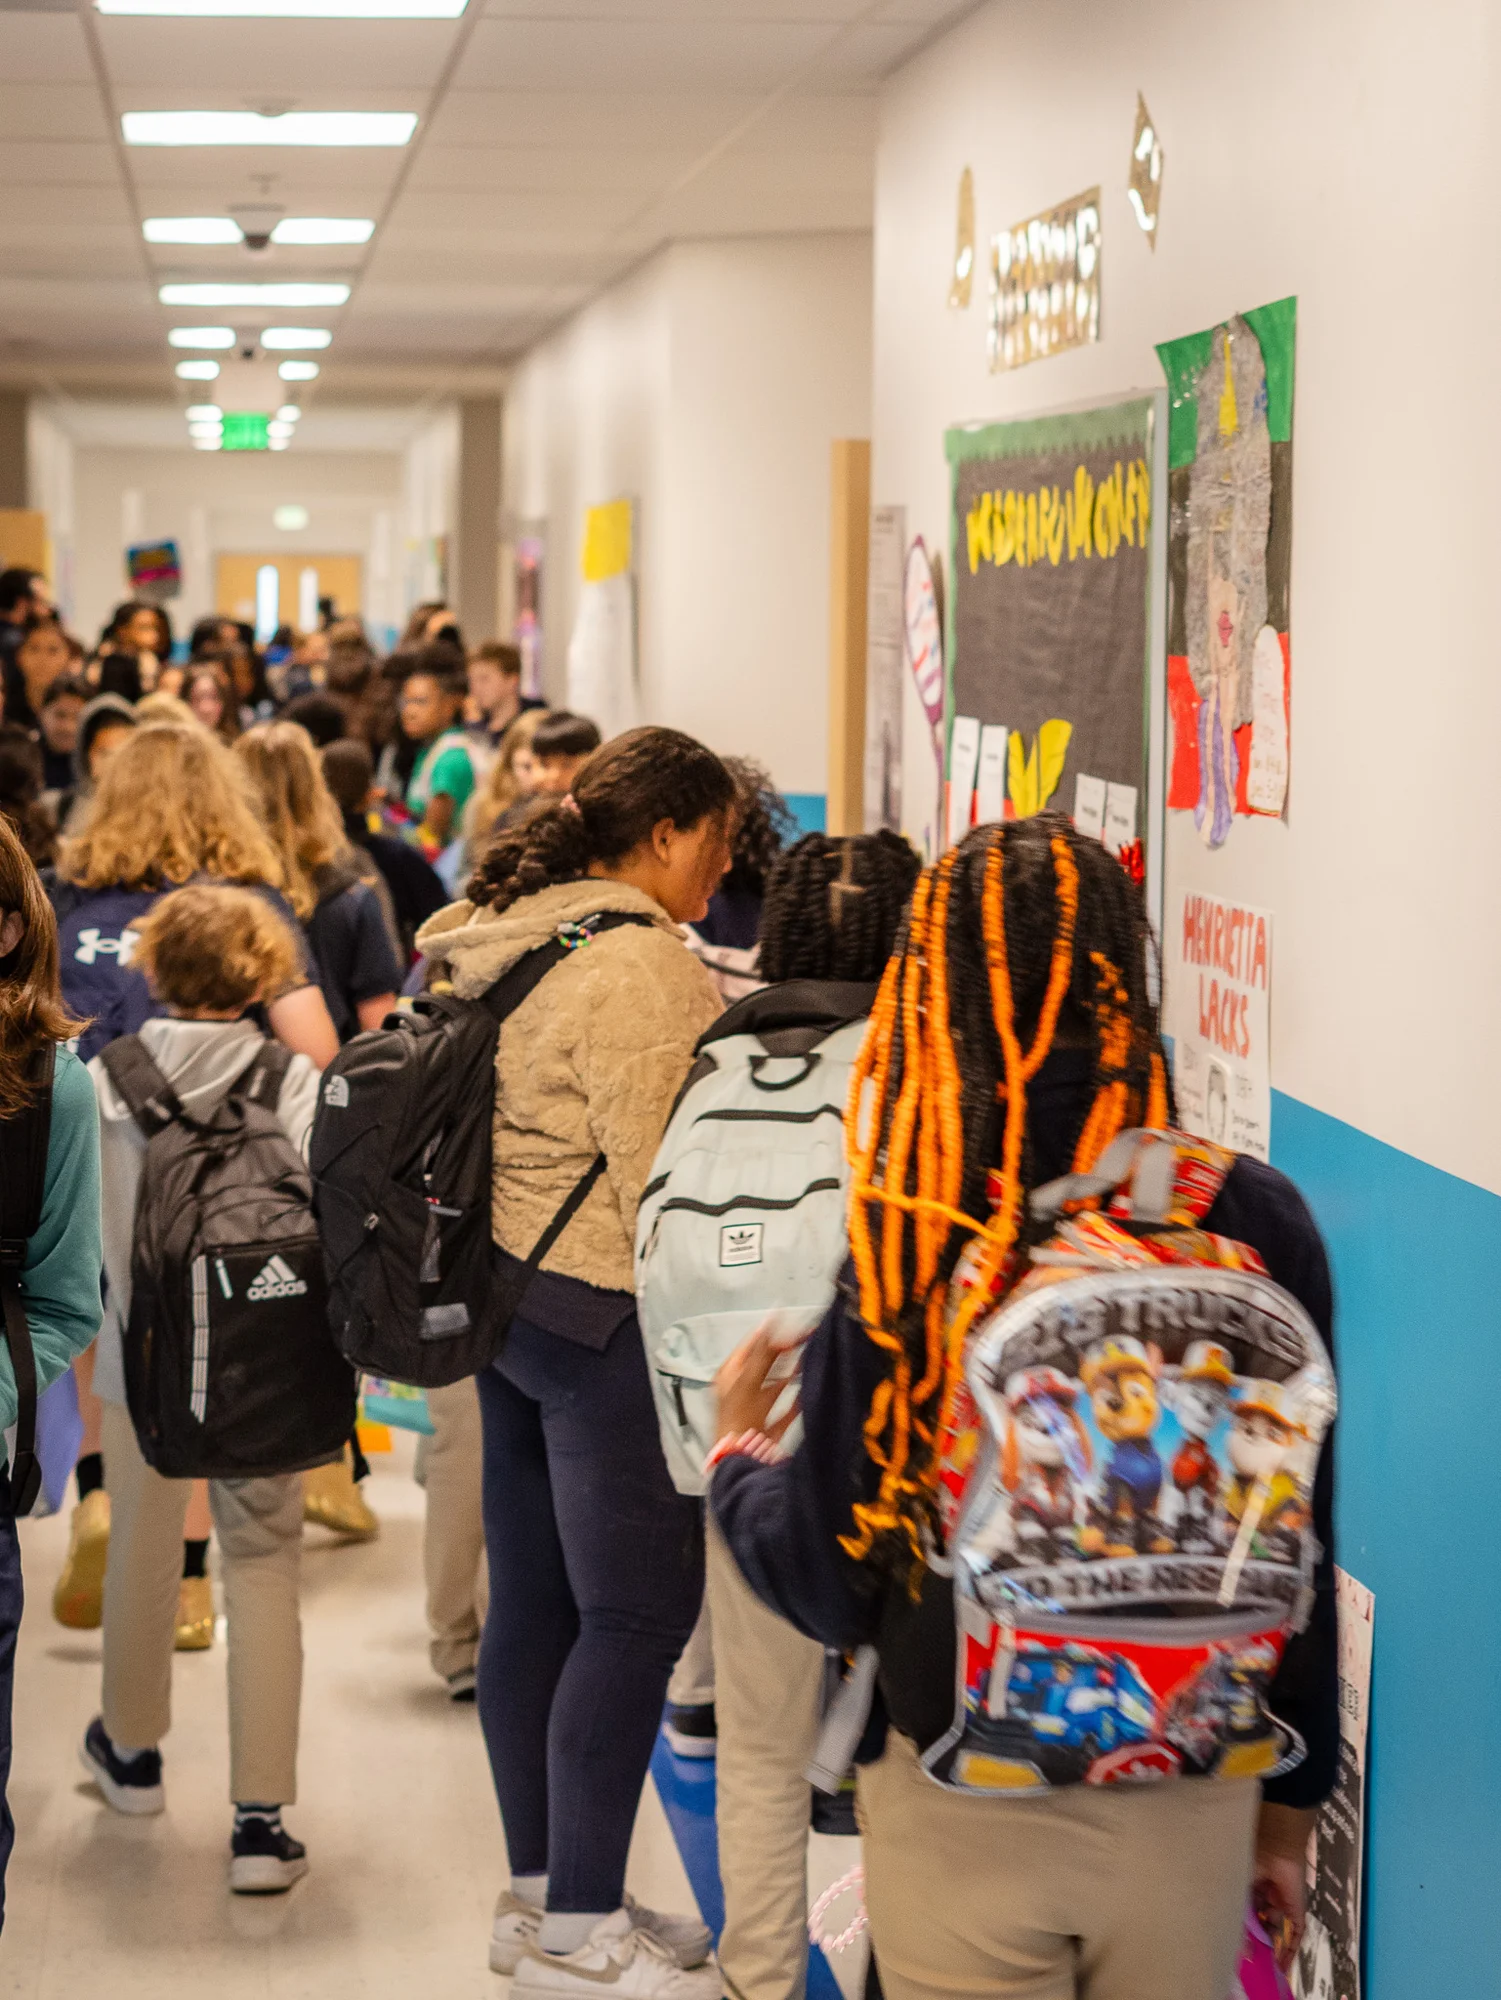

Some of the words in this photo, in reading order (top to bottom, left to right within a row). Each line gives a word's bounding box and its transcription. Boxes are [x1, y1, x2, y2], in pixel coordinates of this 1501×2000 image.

[1183, 893, 1266, 991] HENRIETTA
[1199, 973, 1250, 1060] LACKS
[247, 1279, 308, 1302] adidas
